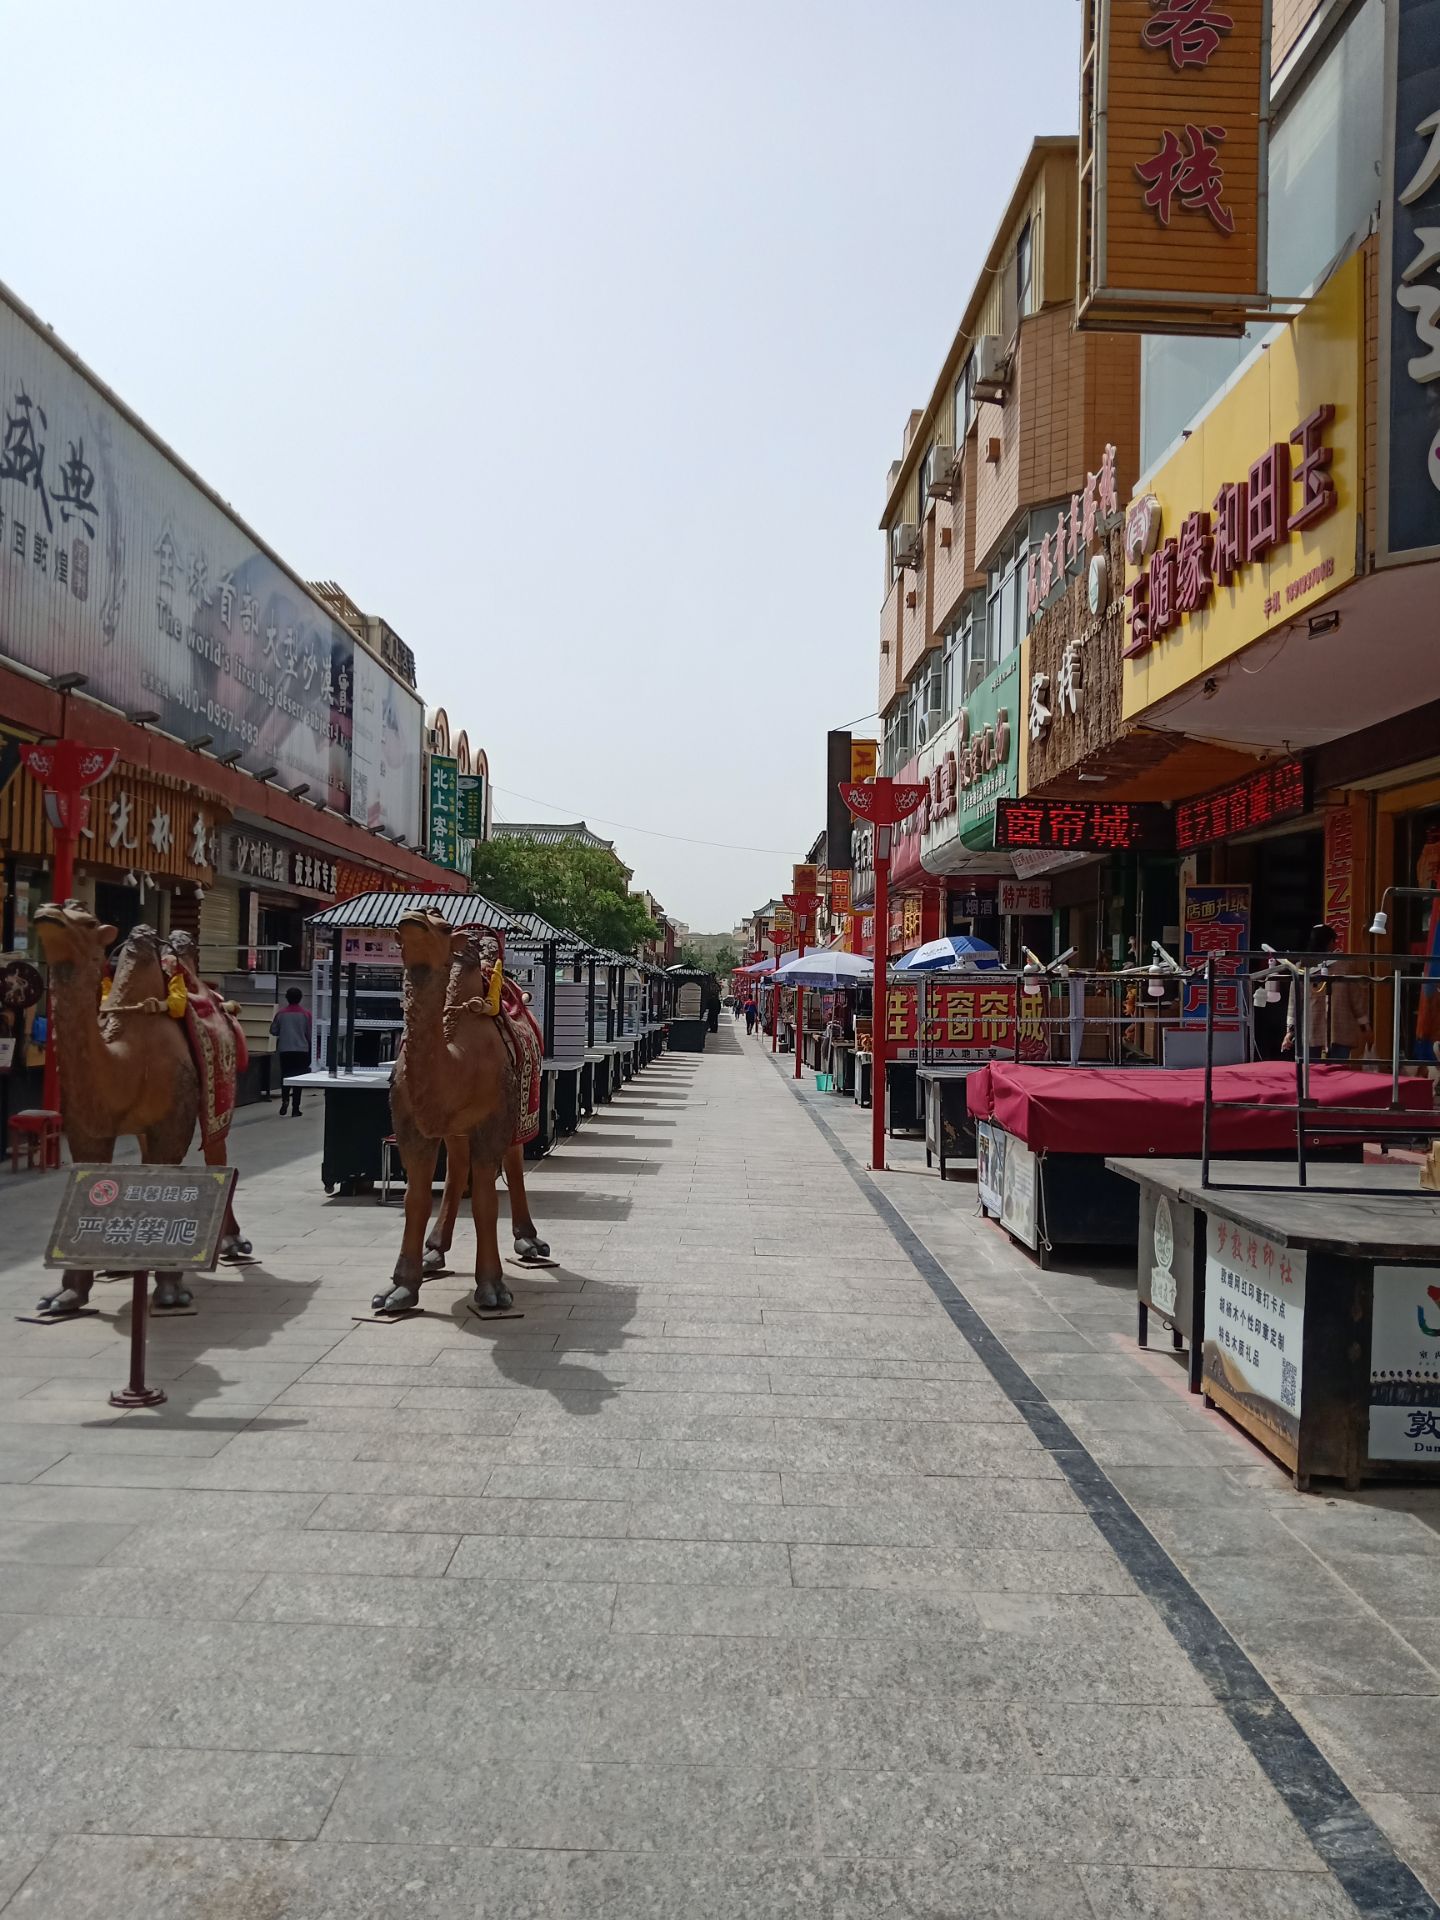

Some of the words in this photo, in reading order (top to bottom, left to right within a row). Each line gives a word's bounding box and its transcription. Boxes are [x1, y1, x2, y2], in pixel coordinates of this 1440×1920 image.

[1134, 0, 1236, 233] 客栈
[1121, 403, 1338, 661] 玉随缘和田玉
[156, 599, 182, 642] The
[186, 628, 230, 672] world's
[234, 654, 256, 690] first
[258, 671, 275, 707] big
[276, 688, 303, 722] desert
[1029, 639, 1084, 742] 客栈
[432, 768, 449, 863] 北上客栈
[1005, 806, 1131, 848] 窗帘城
[966, 899, 993, 915] 烟酒
[1002, 885, 1051, 910] 特产超市
[1186, 894, 1250, 921] 店面升级
[884, 990, 1045, 1042] 佳艺窗帘城
[908, 1048, 998, 1059] 由此进入地下室
[124, 1185, 199, 1203] 温馨提示
[71, 1216, 199, 1246] 严禁攀爬
[1216, 1222, 1294, 1284] 梦敦煌印社
[1221, 1267, 1286, 1320] 敦煌网红印章打卡点
[1218, 1325, 1261, 1368] 特色木质礼品
[1219, 1296, 1285, 1352] 胡杨木个性印章定制
